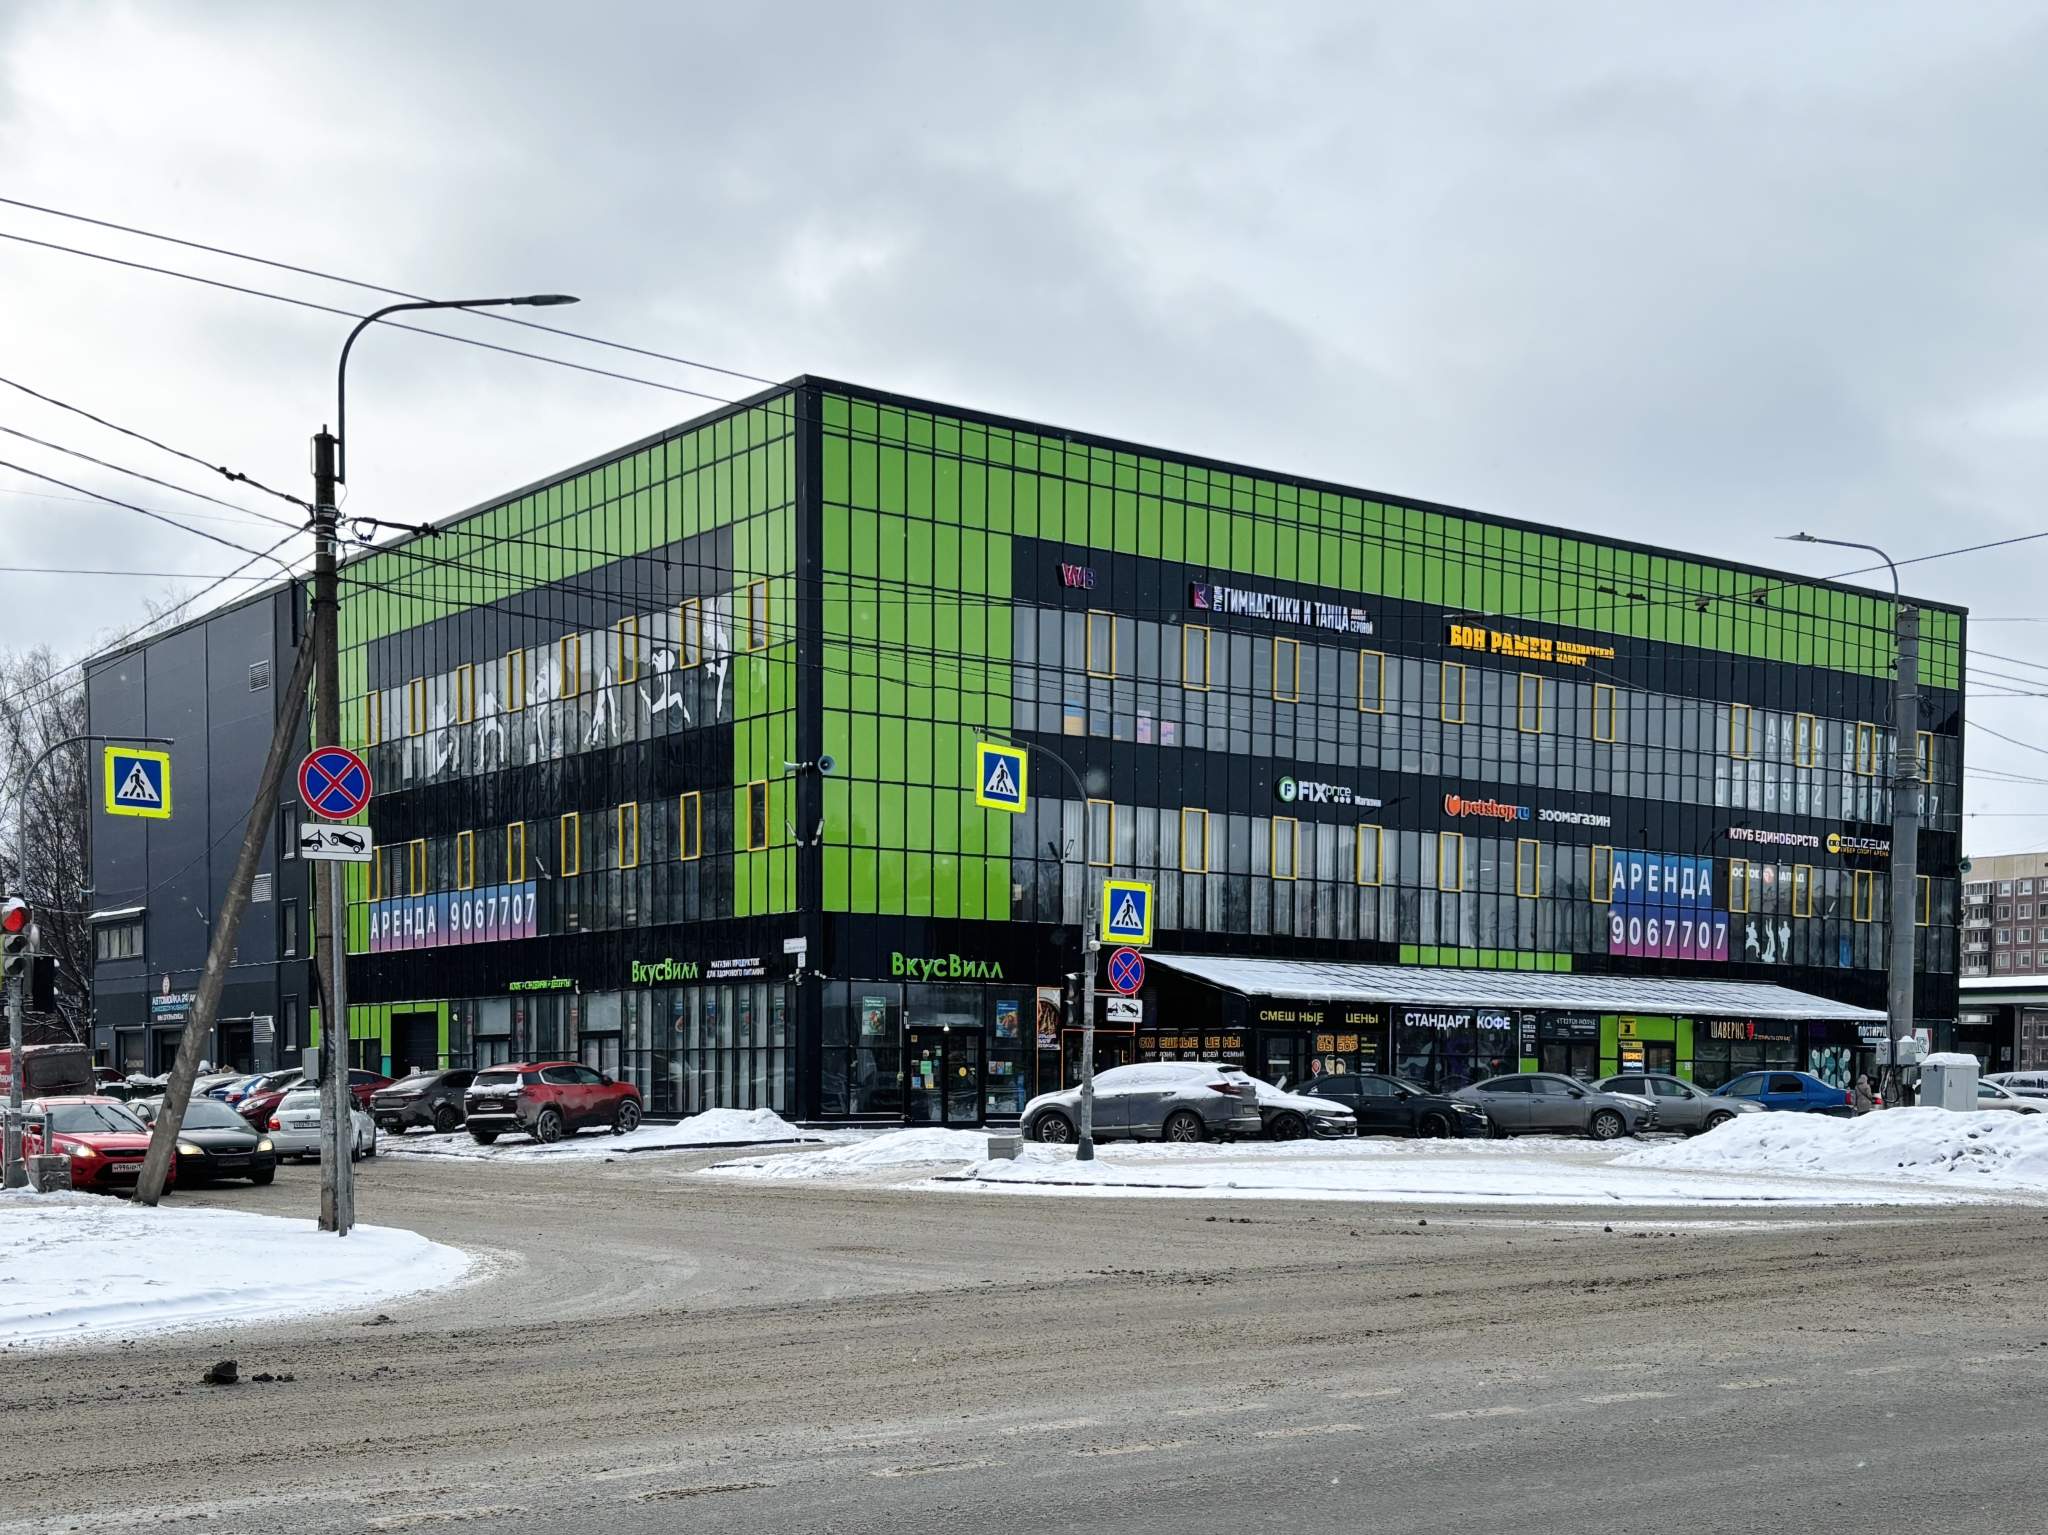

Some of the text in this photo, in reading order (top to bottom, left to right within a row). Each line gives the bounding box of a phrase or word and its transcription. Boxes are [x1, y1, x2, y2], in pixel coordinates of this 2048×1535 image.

[1224, 588, 1349, 634] ГИМНАСТИКИ И ТАНЦА
[1450, 625, 1552, 661] БОН РАМЕН
[1767, 718, 1926, 762] АКРО БАТИА
[1729, 827, 1819, 848] КЛУБ ЕДИНОБОРСТВ
[1612, 862, 1711, 900] АРЕНДА
[371, 893, 535, 940] АРЕНДА 9067707
[1612, 915, 1726, 950] 9067707
[632, 958, 698, 987] ВкусВилл
[891, 952, 1004, 981] ВкусВилл
[1346, 1013, 1379, 1024] ЦЕНЫ
[1405, 1013, 1470, 1030] СТАНДАРТ
[1475, 1014, 1511, 1030] КОФЕ
